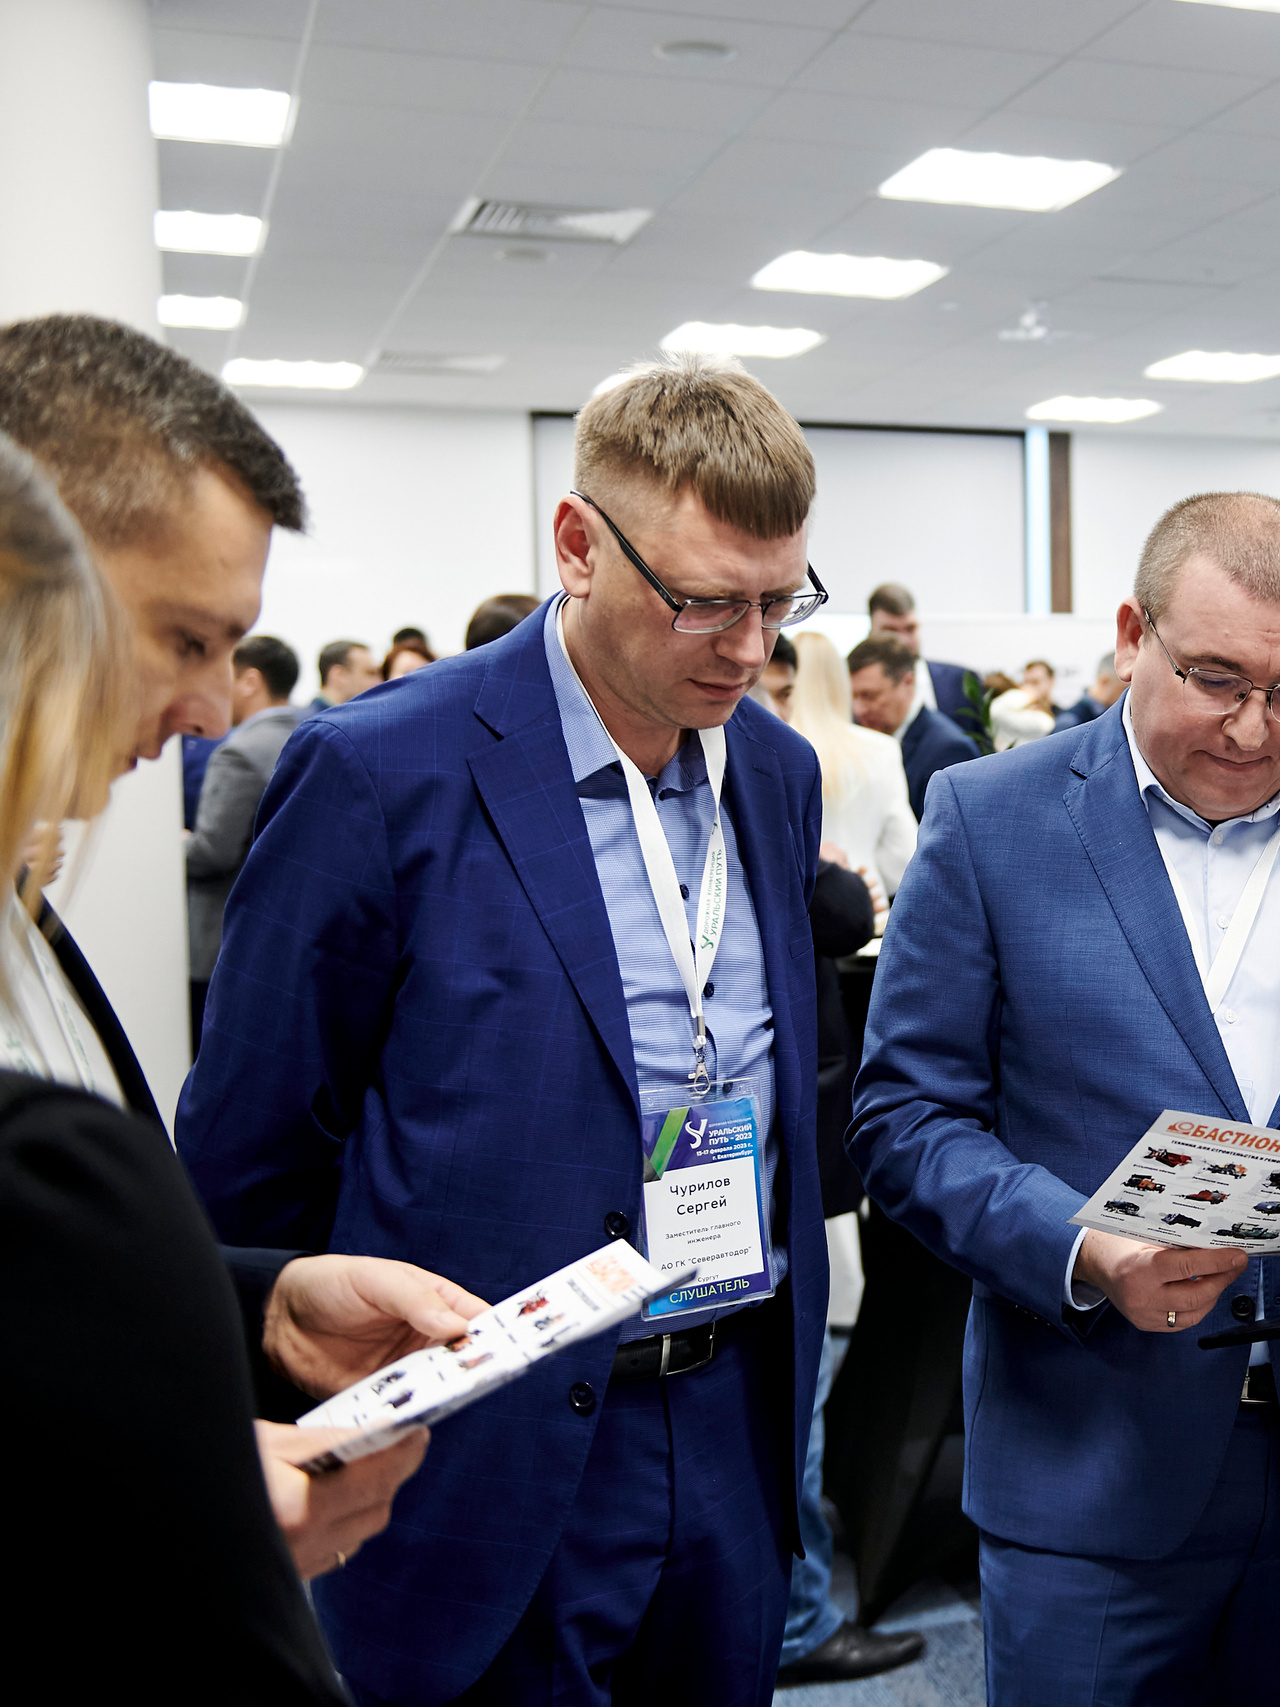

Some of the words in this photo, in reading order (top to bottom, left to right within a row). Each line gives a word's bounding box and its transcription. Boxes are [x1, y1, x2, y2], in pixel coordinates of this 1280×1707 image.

[715, 849, 723, 876] ПУТЬ
[710, 877, 722, 936] УРАЛЬСКИЙ
[708, 1123, 752, 1138] УРАЛЬСКИЙ
[709, 1136, 729, 1146] ПУТЬ
[735, 1132, 753, 1141] 2023
[669, 1177, 731, 1197] Чурилов
[676, 1195, 727, 1216] Сергей
[665, 1226, 709, 1240] Заместитель
[710, 1220, 742, 1230] главного
[687, 1233, 722, 1245] инженера
[660, 1262, 673, 1271] АО
[675, 1259, 686, 1268] ГК
[688, 1246, 752, 1265] "Северавтодор"
[697, 1274, 719, 1283] Сургут
[669, 1278, 750, 1304] СЛУШАТЕЛЬ
